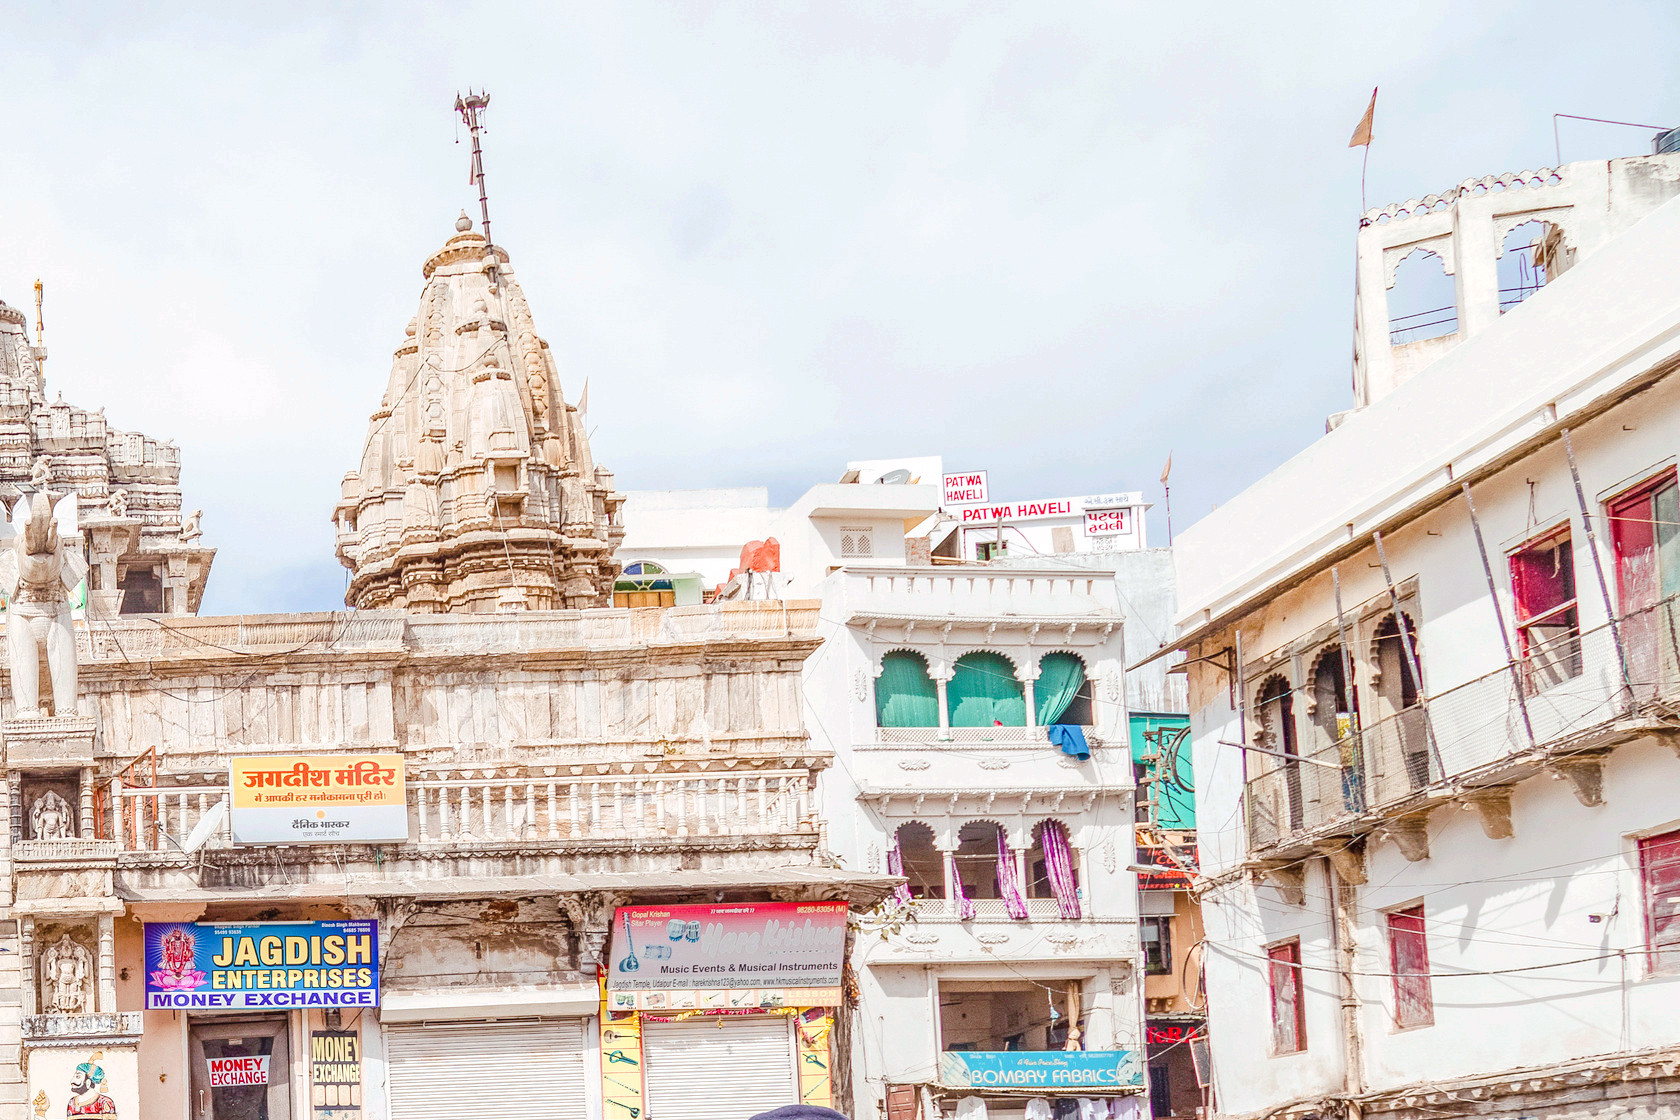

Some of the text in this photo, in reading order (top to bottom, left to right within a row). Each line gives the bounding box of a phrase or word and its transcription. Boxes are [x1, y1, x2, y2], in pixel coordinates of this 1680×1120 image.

[945, 475, 982, 487] PATWA
[946, 489, 983, 501] HAVELI
[963, 502, 1070, 521] PATWA HAVELI
[1088, 512, 1123, 521] પટવા
[243, 761, 396, 788] जगदीश मंदिर
[254, 793, 263, 802] में
[264, 792, 294, 802] आपकी
[295, 794, 307, 802] हर
[309, 792, 355, 801] मनोकामना
[357, 791, 372, 803] पूरी
[292, 819, 350, 829] दैनिक भास्कर
[632, 911, 648, 919] Gopal
[212, 935, 371, 967] JAGDISH
[660, 962, 838, 974] Music Events & Musical Instruments
[212, 968, 372, 990] ENTERPRISES
[153, 991, 372, 1007] MONEY EXCHANGE
[313, 1036, 358, 1062] MONEY
[211, 1058, 264, 1072] MONEY
[211, 1071, 267, 1086] EXCHANGE
[313, 1064, 360, 1083] EXCHANGE
[971, 1069, 1117, 1084] BOMBAY FABRICS
